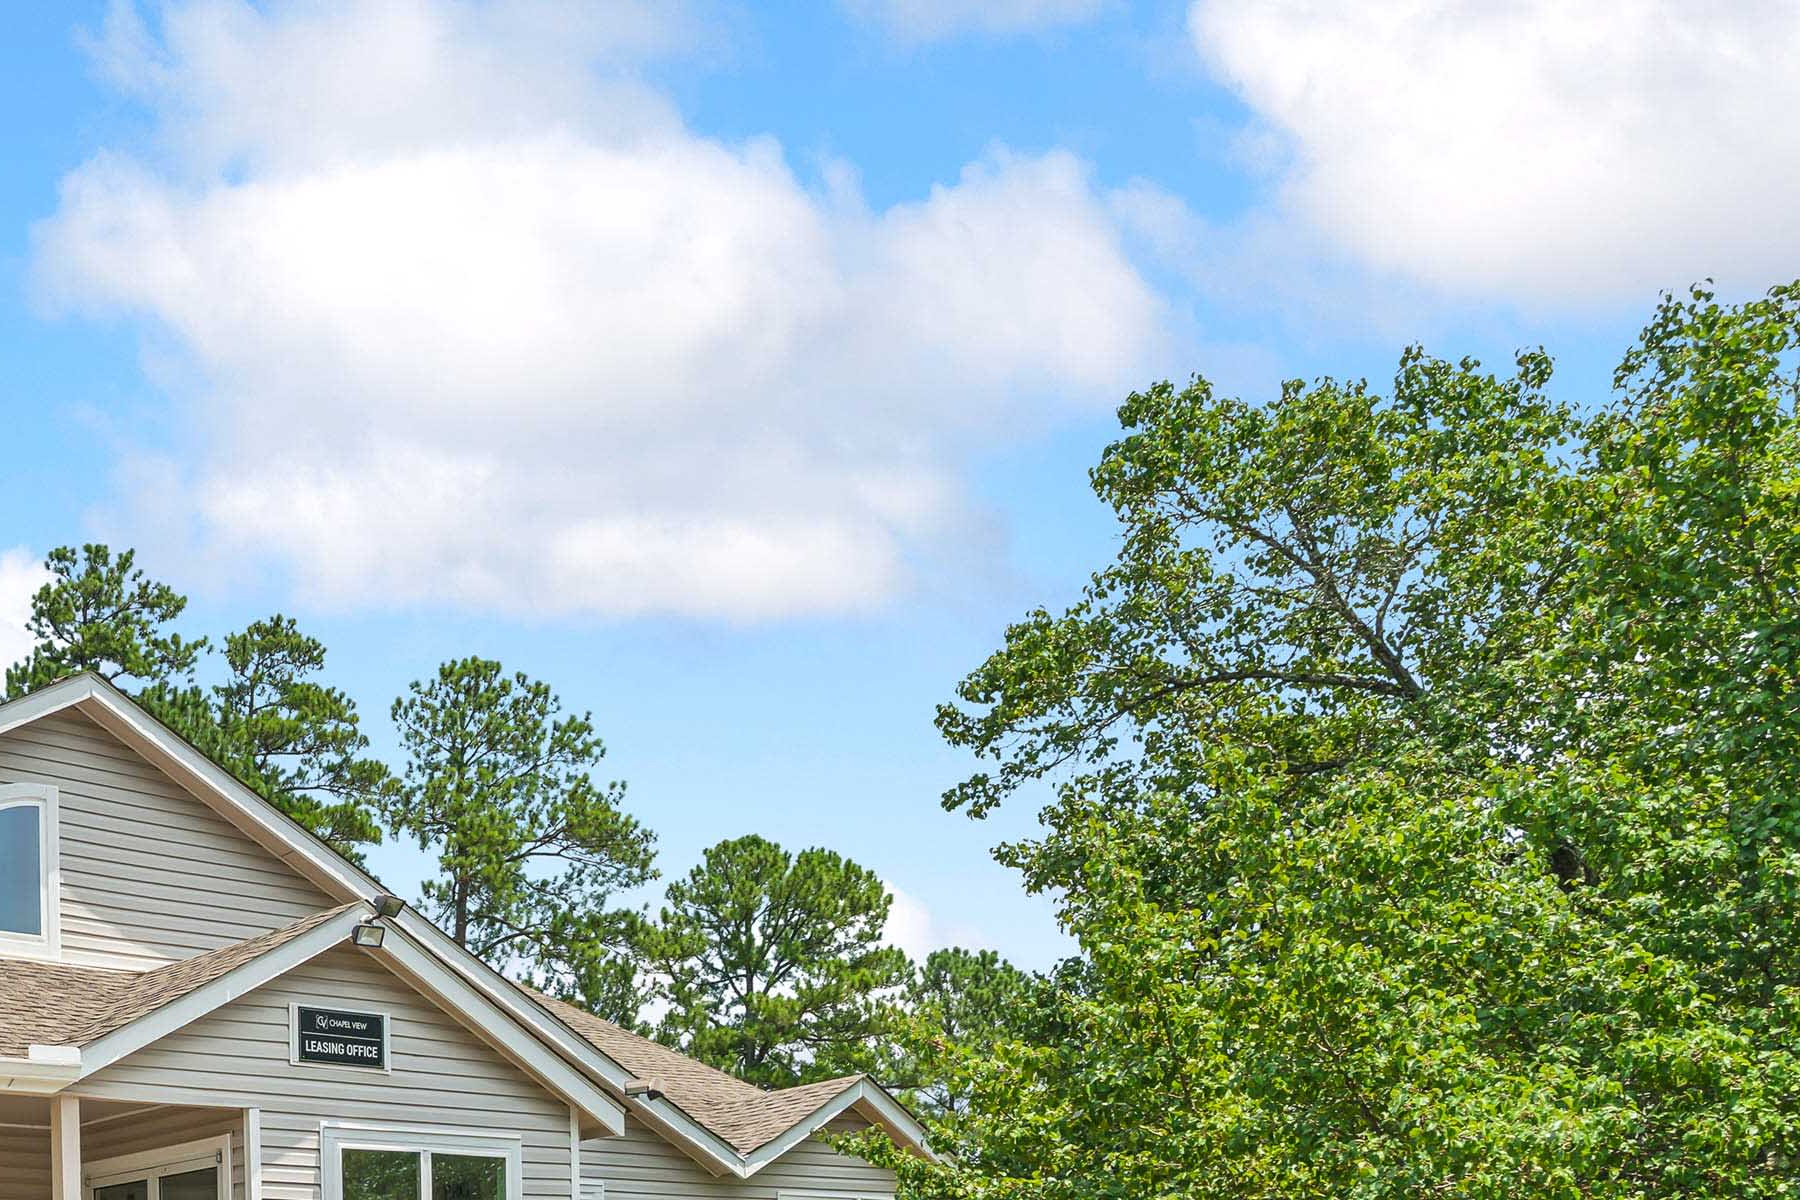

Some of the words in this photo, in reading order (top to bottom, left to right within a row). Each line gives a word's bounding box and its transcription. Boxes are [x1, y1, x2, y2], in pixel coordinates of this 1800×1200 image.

[329, 1019, 351, 1029] CHAPEL
[351, 1022, 367, 1030] VIEW
[305, 1040, 344, 1055] LEASING
[346, 1044, 378, 1058] OFFICE
